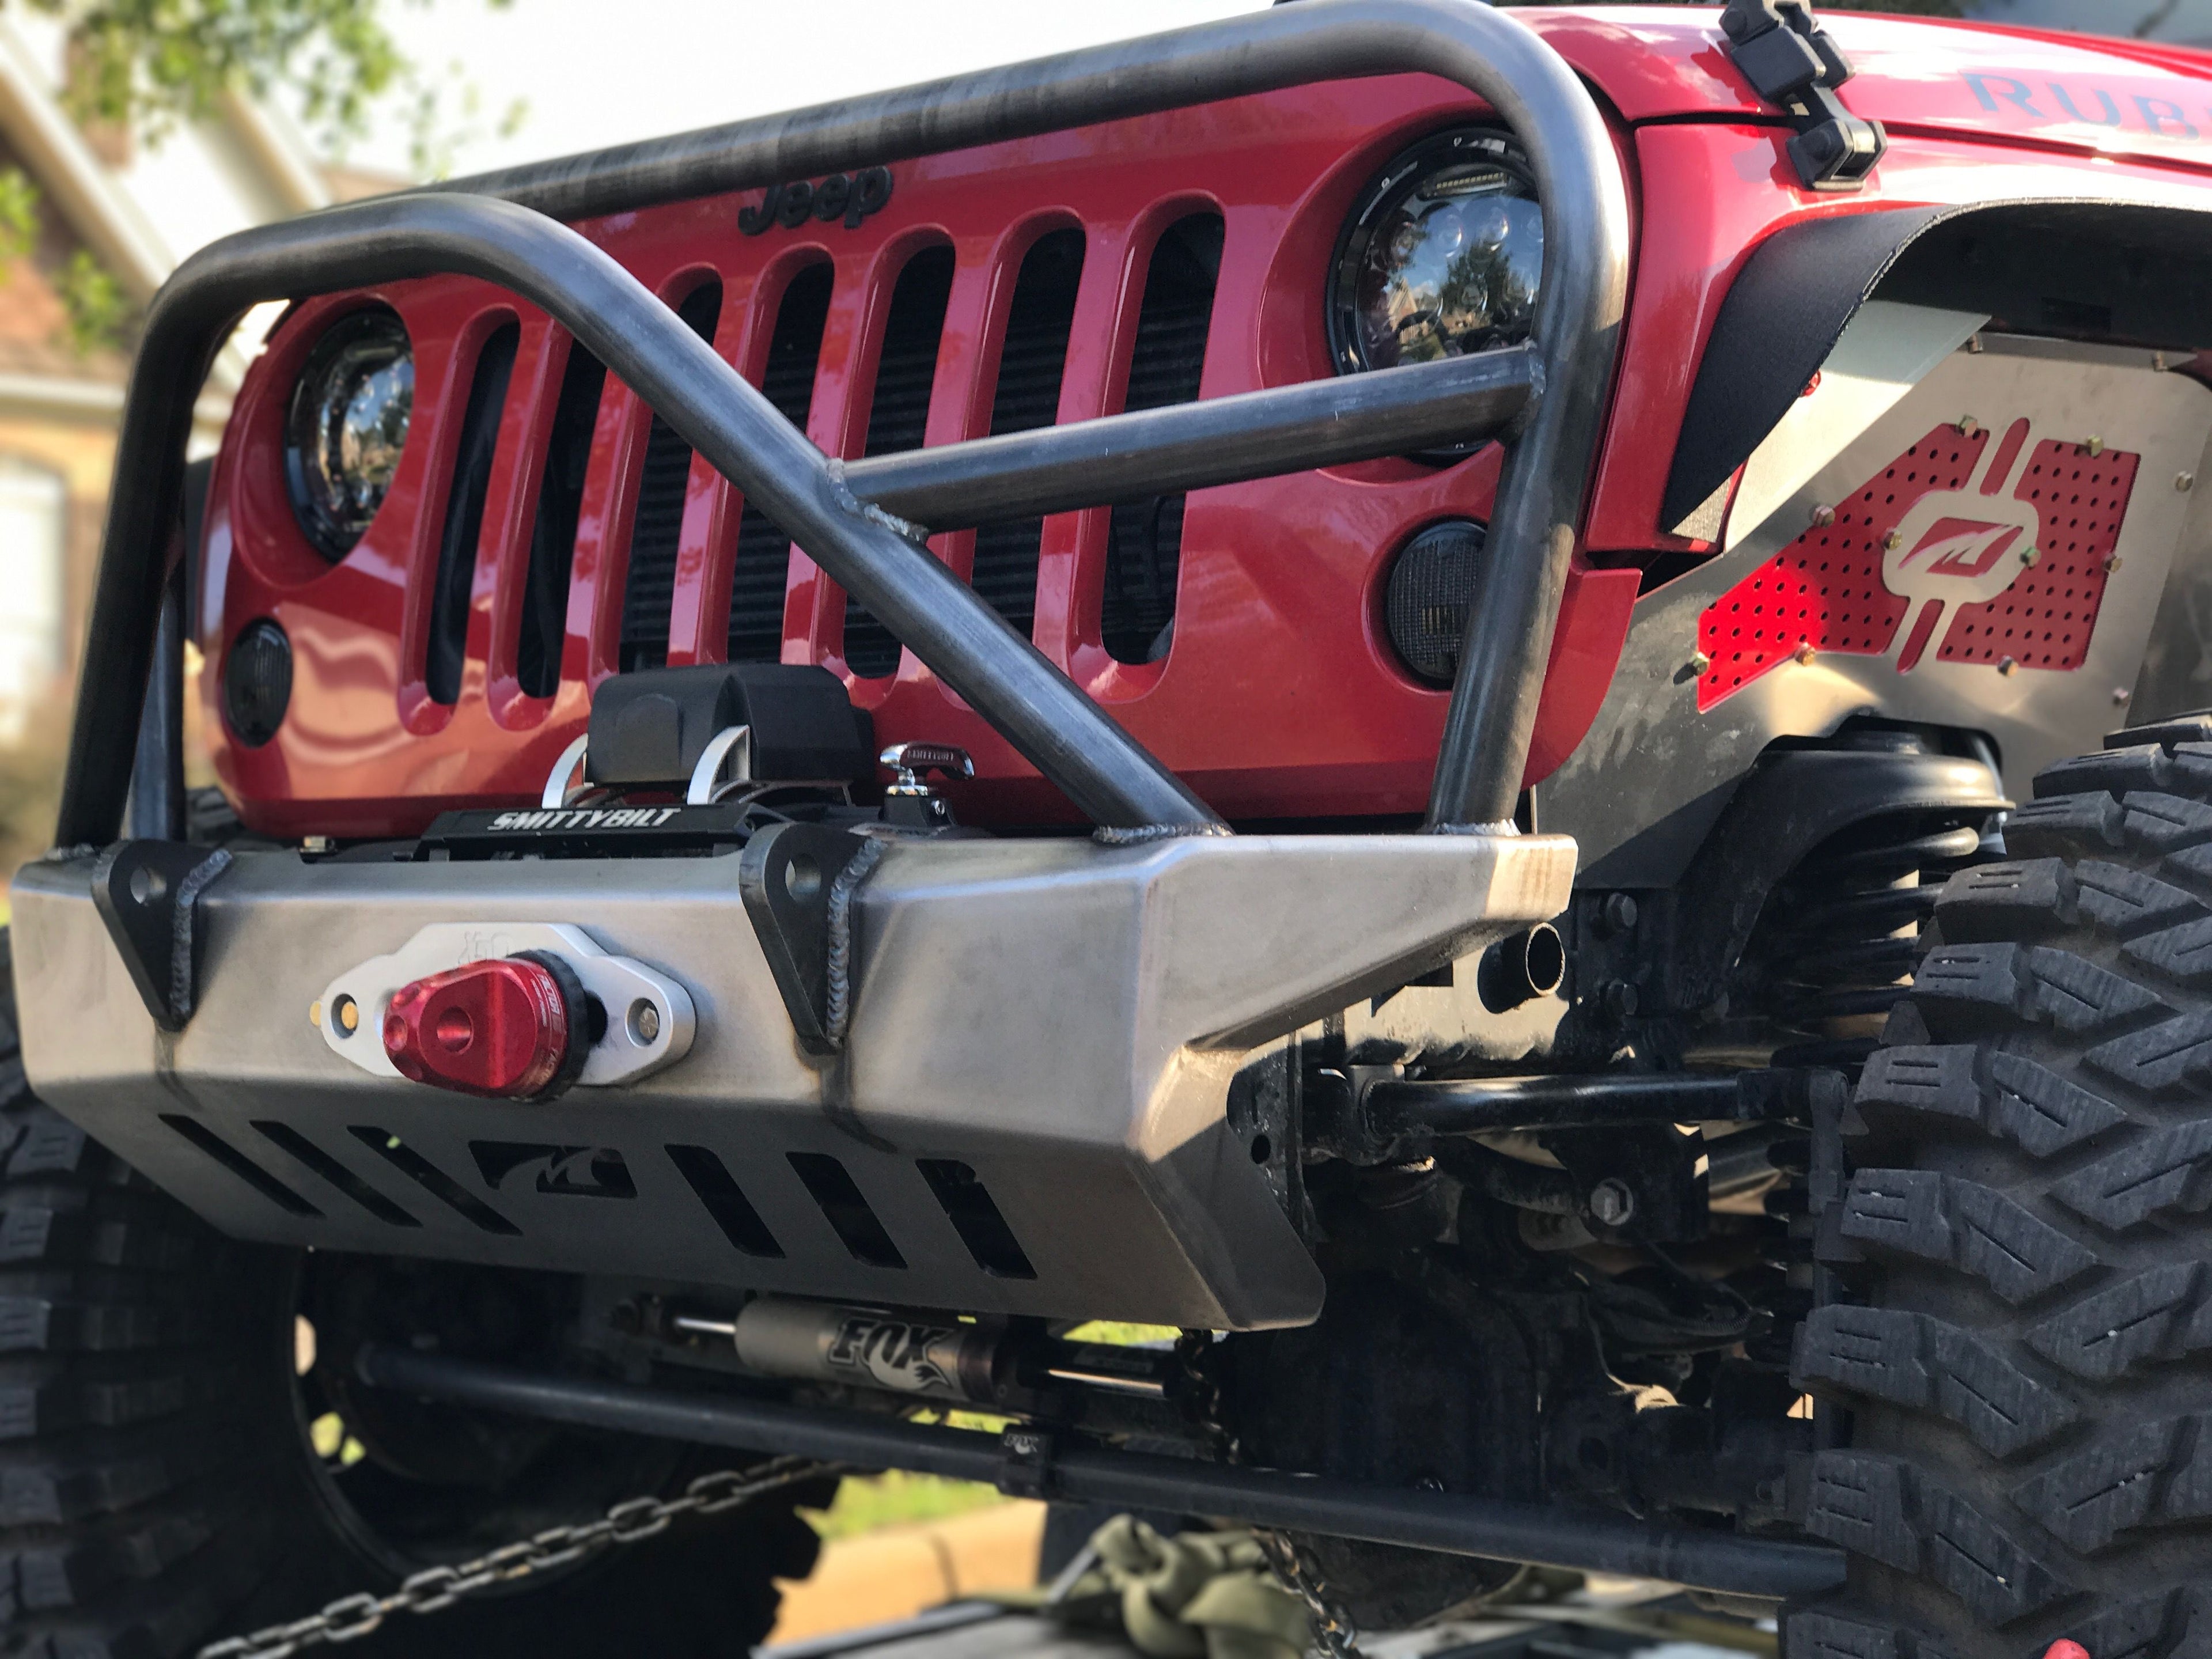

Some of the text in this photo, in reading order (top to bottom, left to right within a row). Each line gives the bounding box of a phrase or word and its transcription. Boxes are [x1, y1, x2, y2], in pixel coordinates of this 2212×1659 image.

[1959, 71, 2212, 141] RUB
[738, 165, 894, 237] Jeep
[487, 808, 681, 831] SMITTYBILT
[828, 1316, 954, 1387] FOX
